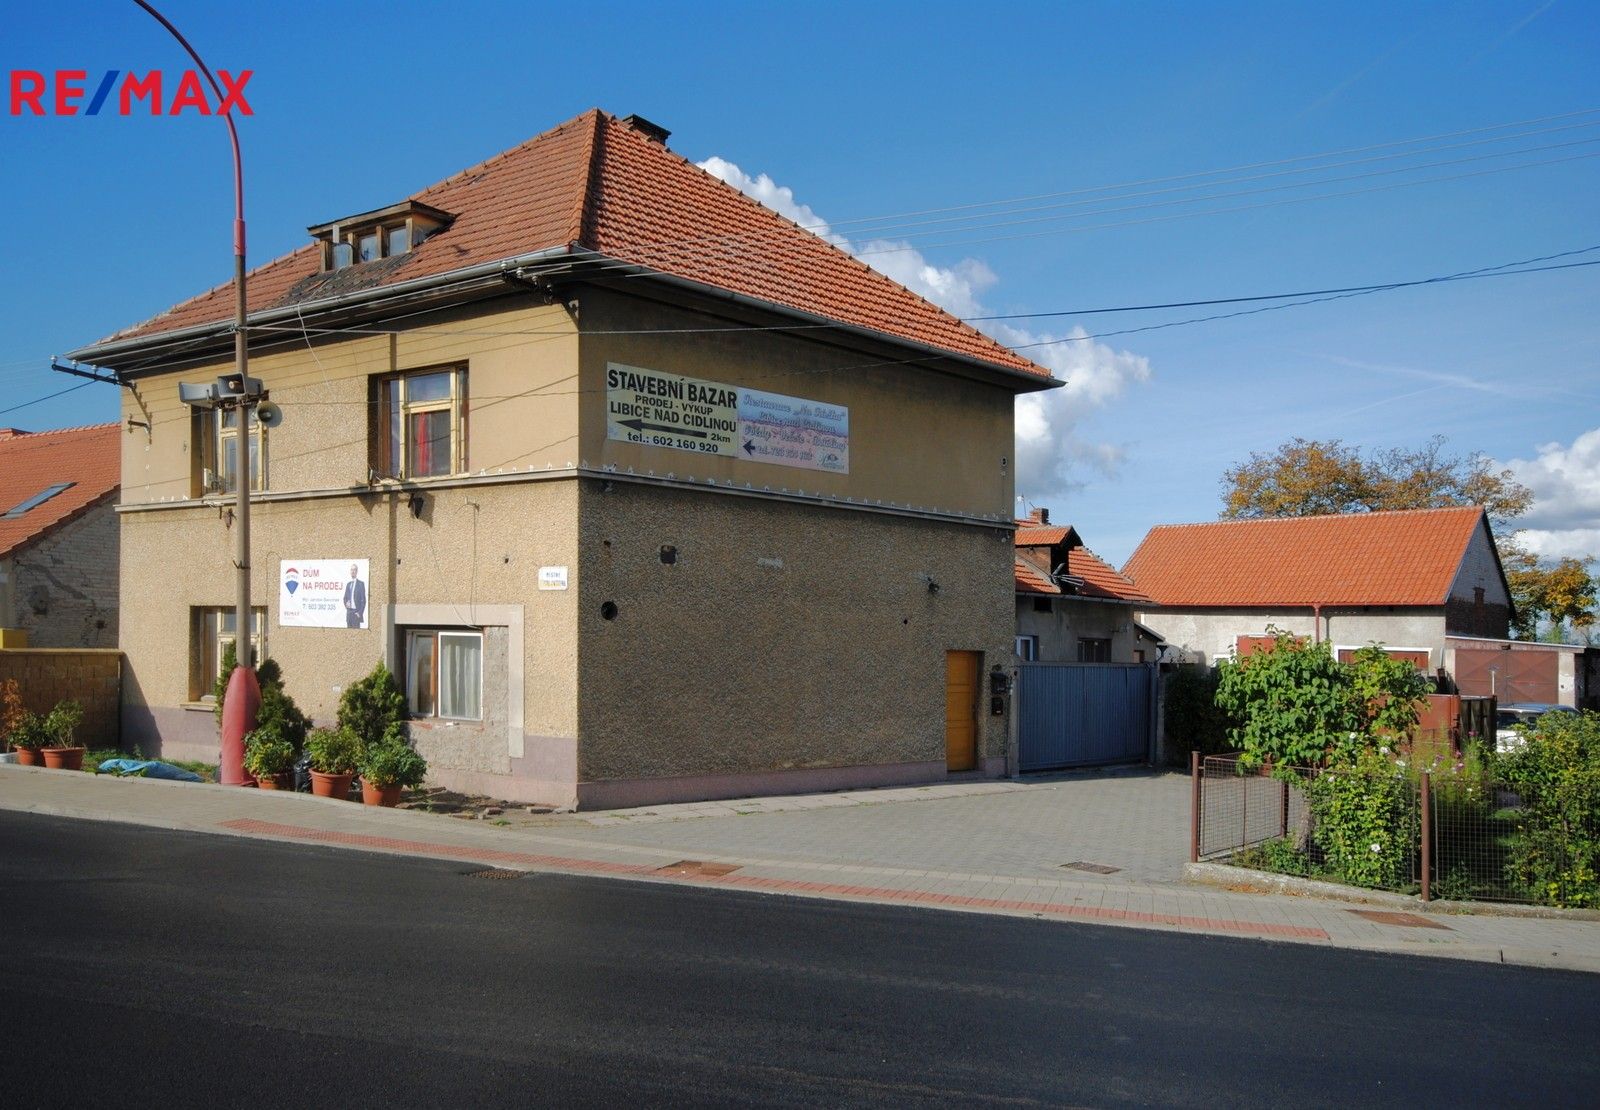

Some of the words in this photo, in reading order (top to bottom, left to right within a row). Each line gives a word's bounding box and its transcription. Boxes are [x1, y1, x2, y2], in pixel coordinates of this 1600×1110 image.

[608, 369, 685, 400] STAVEBNÍ
[688, 383, 737, 409] BAZAR
[635, 395, 673, 409] PRODEJ
[682, 401, 713, 415] VÝKUP
[610, 401, 650, 419] LIBICE
[654, 408, 680, 424] NAD
[683, 414, 737, 432] CIDLINOU
[627, 432, 649, 443] tel.:
[653, 435, 673, 447] 602
[676, 439, 696, 450] 160
[699, 442, 719, 453] 920
[711, 433, 731, 443] 2km
[303, 566, 320, 577] DŮM
[302, 581, 313, 590] NA
[315, 581, 344, 591] PRODEJ
